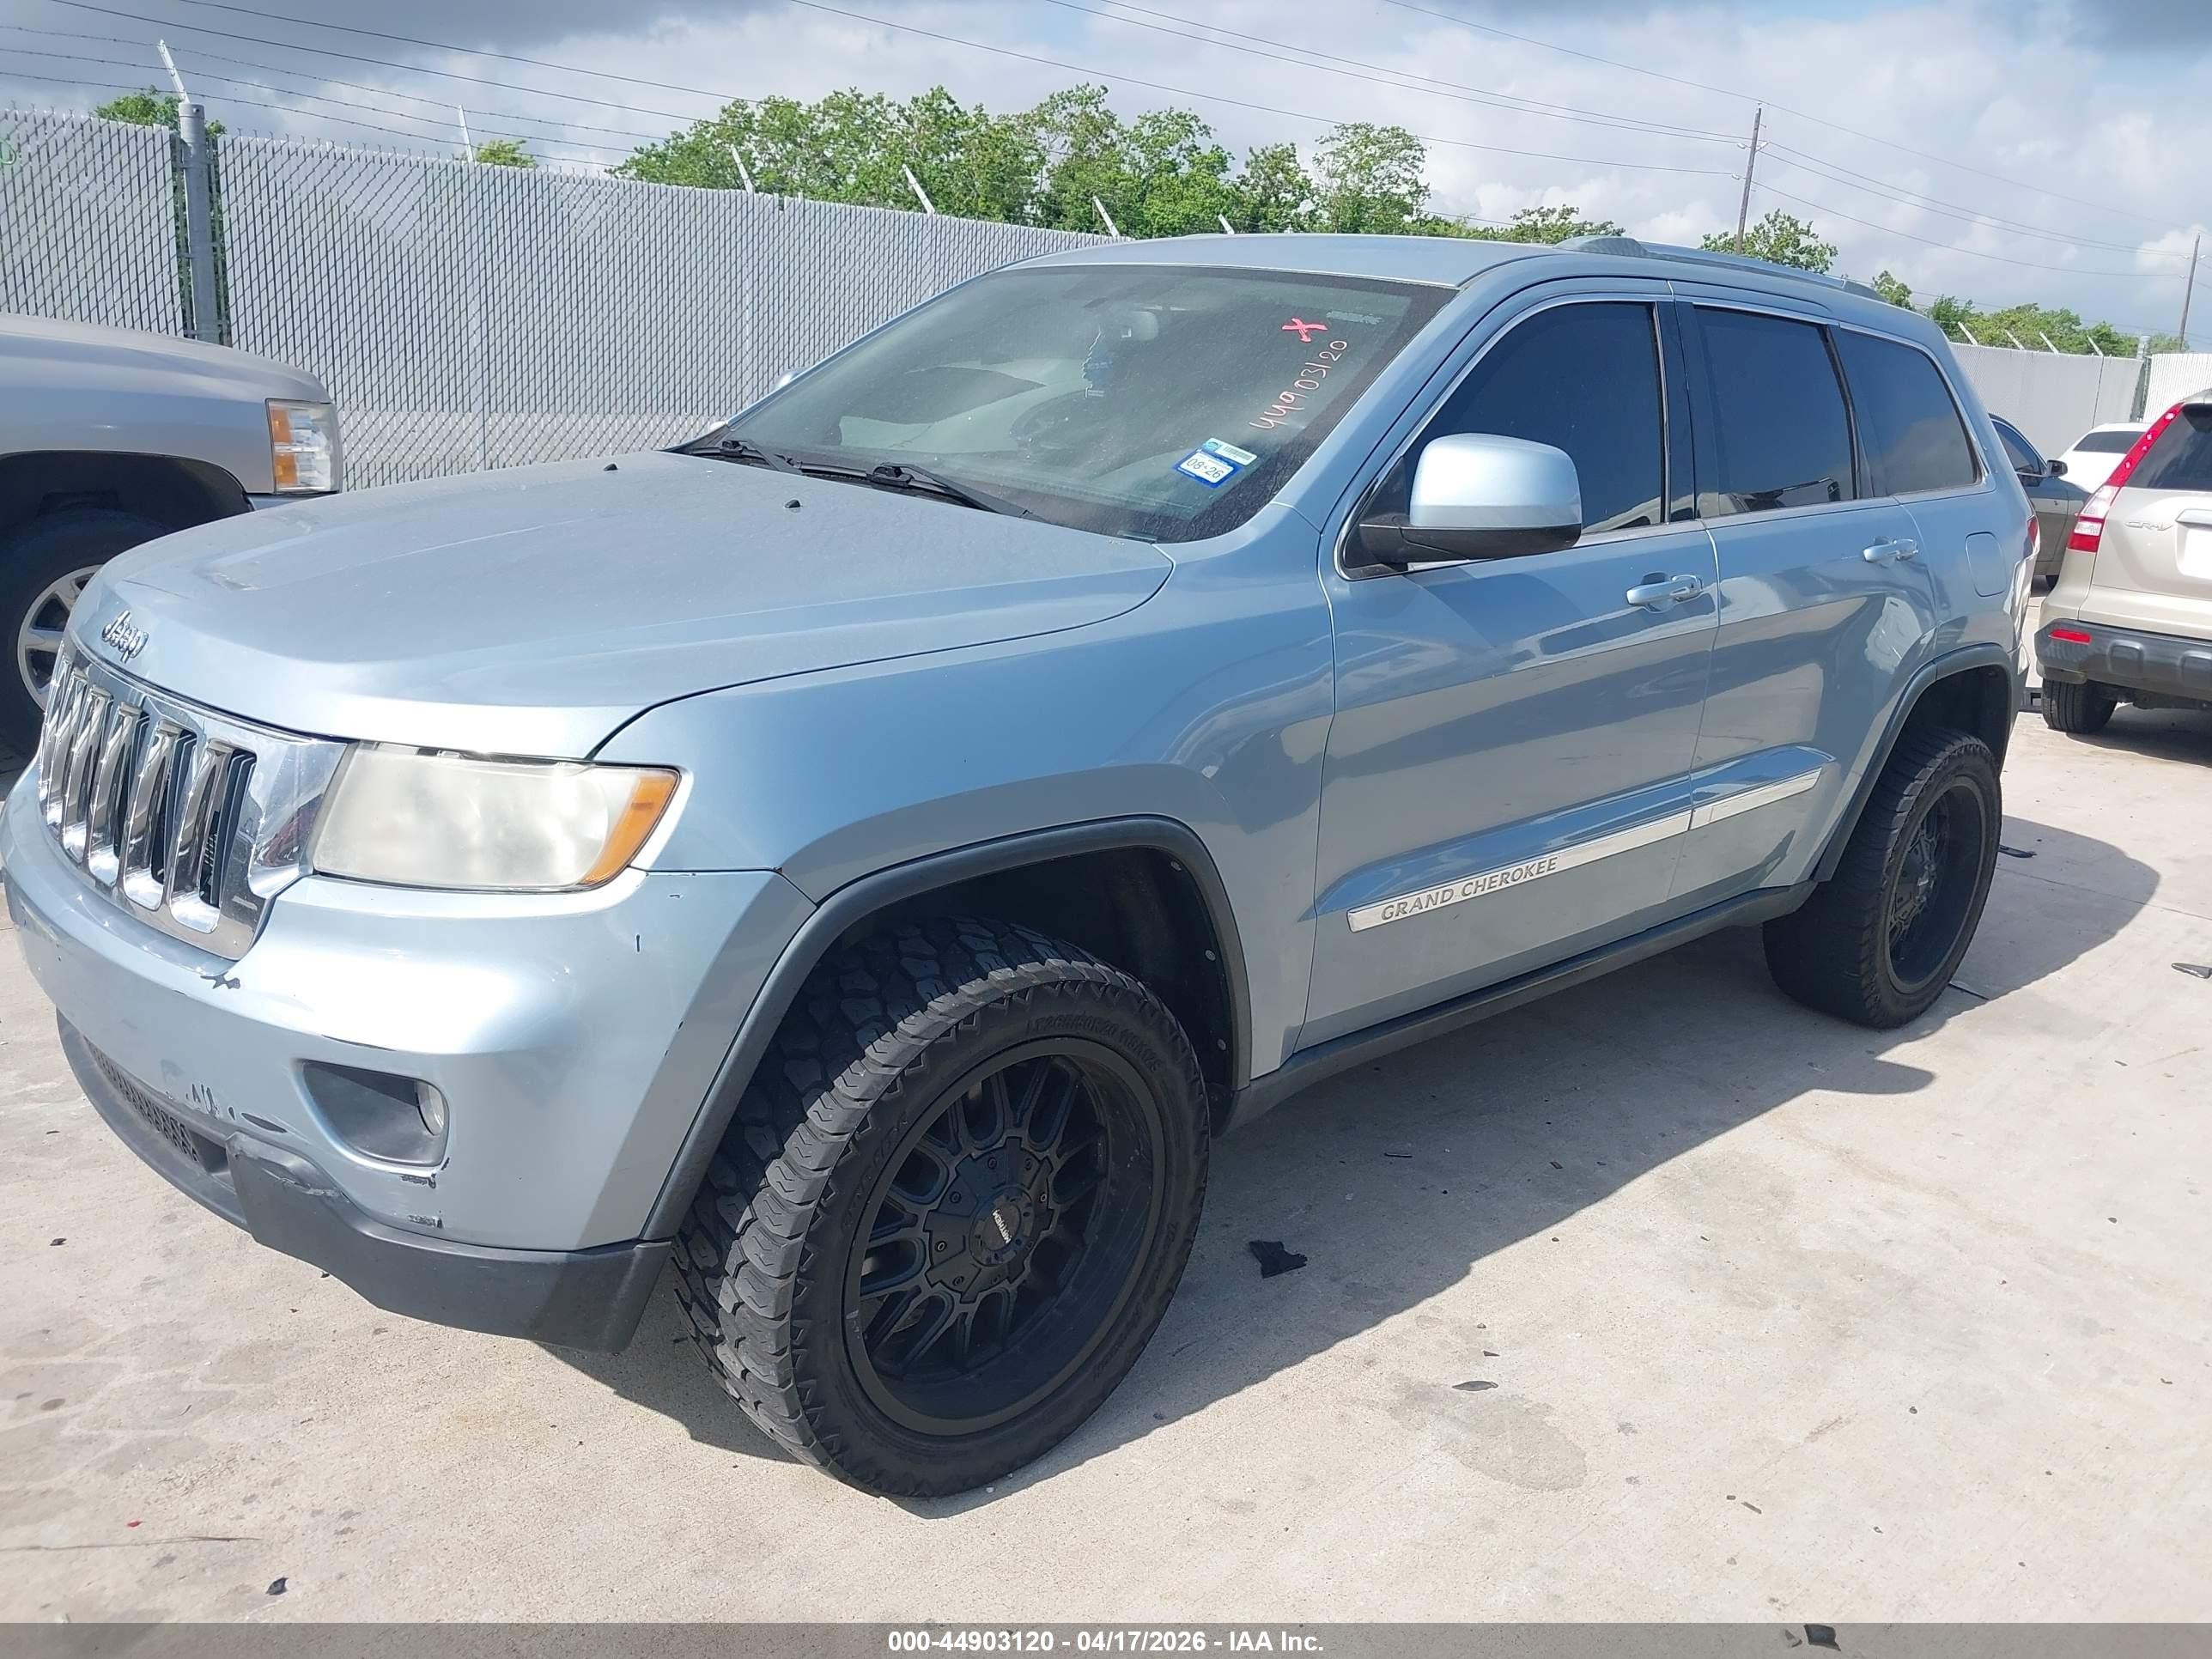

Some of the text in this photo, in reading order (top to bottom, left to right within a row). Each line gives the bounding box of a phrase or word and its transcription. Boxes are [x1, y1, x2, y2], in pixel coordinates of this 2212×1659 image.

[1249, 340, 1347, 429] 44903120
[101, 610, 149, 664] Jeep
[1381, 857, 1559, 921] GRAND CHEROKEE
